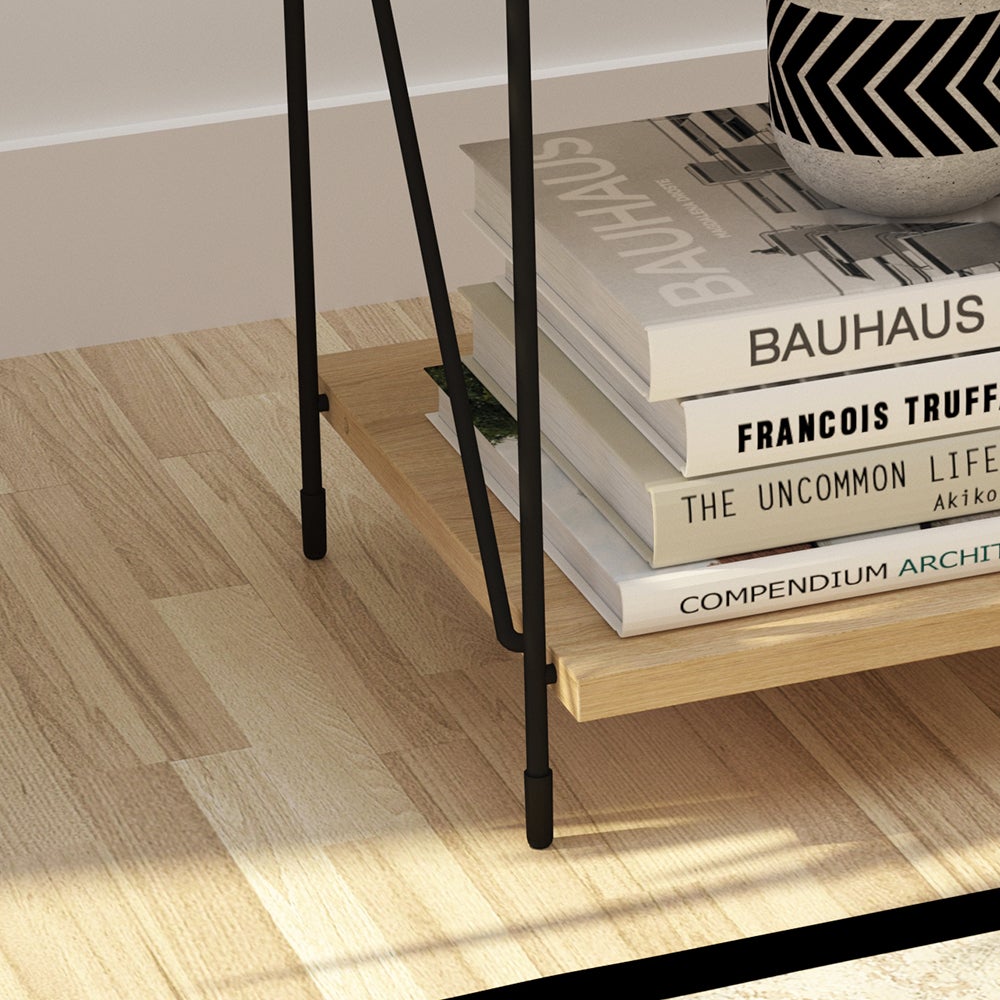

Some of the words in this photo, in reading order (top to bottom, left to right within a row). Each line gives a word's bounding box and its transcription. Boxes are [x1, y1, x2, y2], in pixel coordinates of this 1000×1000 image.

[533, 136, 755, 308] BAUHAUS
[748, 294, 986, 368] BAUHAUS
[737, 400, 890, 454] FRANCOIS
[680, 487, 738, 525] THE
[757, 460, 908, 512] UNCOMMON
[929, 445, 1000, 484] LIFE
[933, 485, 999, 512] Akiko
[679, 562, 889, 615] COMPENDIUM
